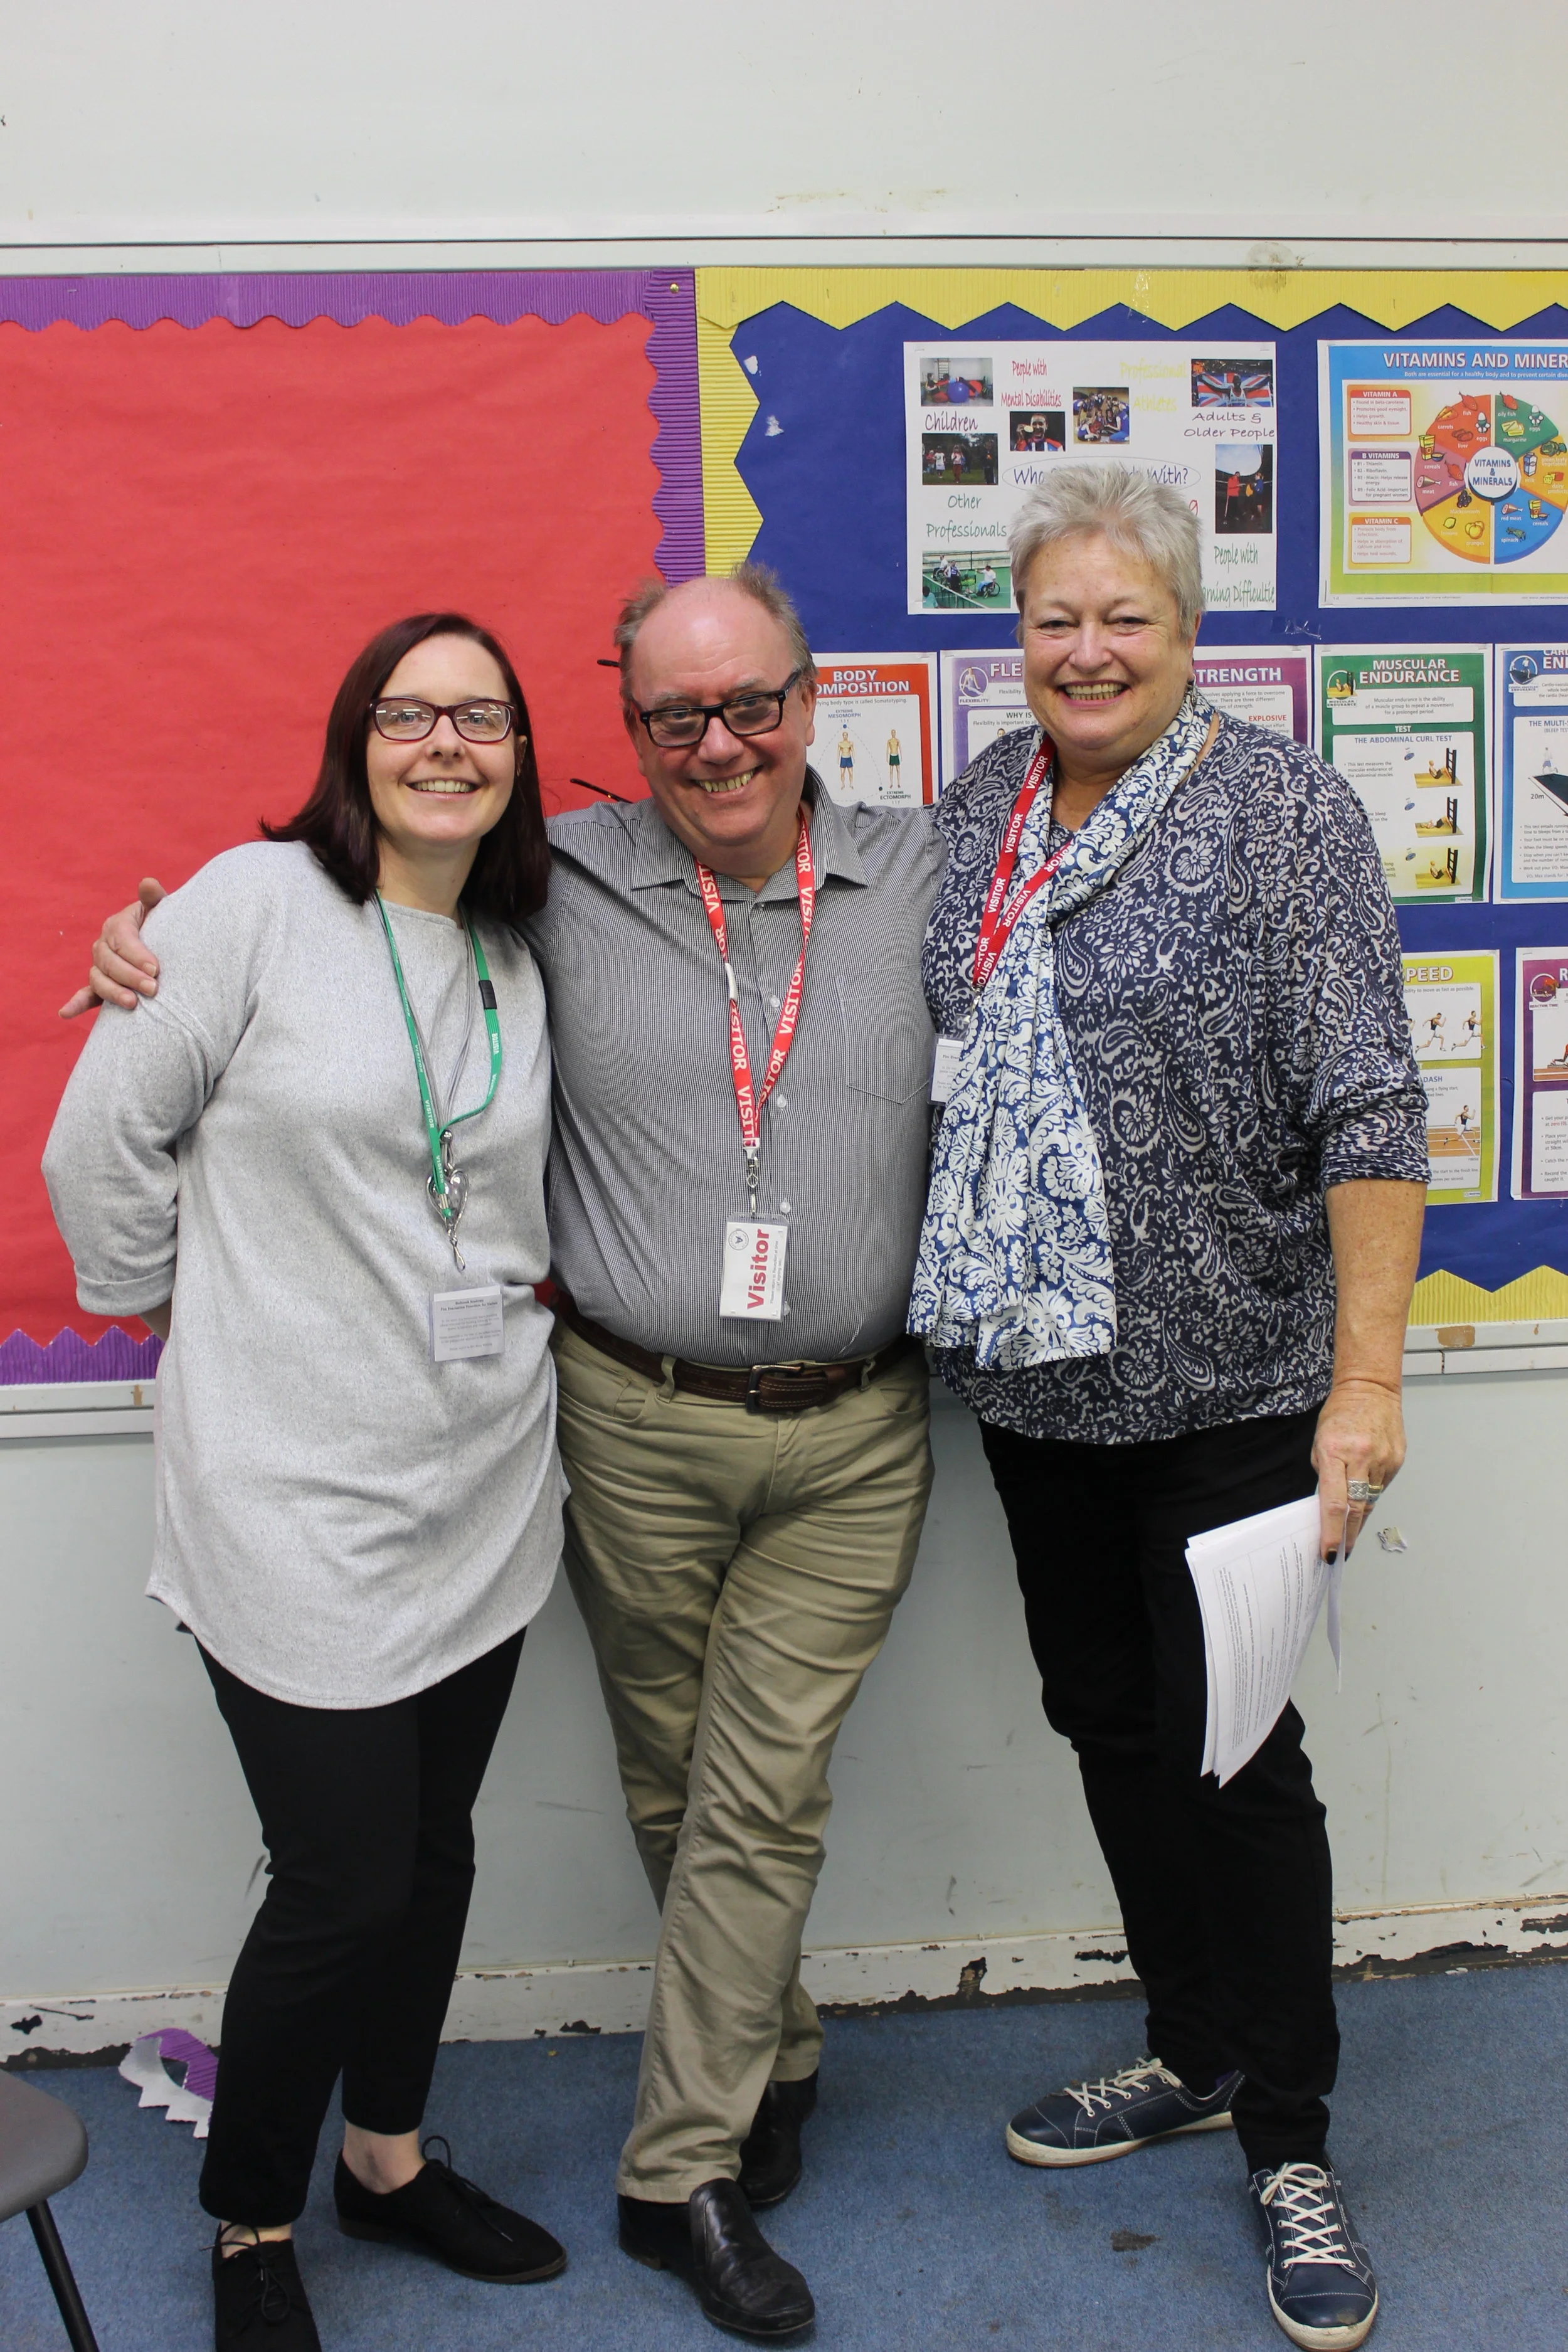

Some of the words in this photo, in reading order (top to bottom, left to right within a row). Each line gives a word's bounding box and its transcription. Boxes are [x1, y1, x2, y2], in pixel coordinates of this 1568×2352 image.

[1012, 359, 1031, 384] People
[1032, 358, 1047, 376] with
[1120, 358, 1187, 384] Professional
[1383, 352, 1466, 368] VITAMINS
[1471, 352, 1509, 368] AND
[1514, 353, 1568, 369] MINER
[1001, 390, 1024, 407] Mental
[1025, 389, 1062, 407] Disabilities
[1133, 393, 1177, 412] Athletes
[925, 411, 978, 432] Children
[1192, 411, 1246, 421] Adults
[1251, 413, 1261, 423] &
[1184, 427, 1226, 437] Older
[1230, 427, 1274, 440] People
[1475, 459, 1511, 467] VITAMINS
[1490, 468, 1495, 476] &
[1013, 465, 1045, 485] Who
[1147, 465, 1189, 485] With?
[1473, 477, 1512, 485] MINERALS
[948, 493, 982, 509] Other
[926, 519, 1007, 543] Professionals
[1214, 543, 1238, 573] People
[1241, 542, 1258, 564] with
[1202, 581, 1231, 608] arning
[1234, 580, 1274, 608] Difficultie
[833, 669, 877, 682] BODY
[1195, 667, 1282, 683] TRENGTH
[1373, 659, 1446, 670] MUSCULAR
[816, 681, 910, 695] OMPOSITION
[1359, 670, 1460, 684] ENDURANCE
[1025, 755, 1047, 790] VISITOR
[1005, 813, 1024, 854] VISITOR
[699, 865, 720, 914] VISIT
[988, 877, 1006, 914] VISITOR
[1003, 889, 1031, 928] VISITOR
[977, 952, 997, 985] VISITO
[1404, 967, 1453, 982] PEED
[779, 960, 803, 1034] VISITOR
[731, 1006, 747, 1071] ISITOR
[415, 1044, 423, 1072] VISITOR
[425, 1099, 435, 1128] VISITOR
[738, 1085, 756, 1138] VISIT
[746, 1229, 769, 1310] Visitor
